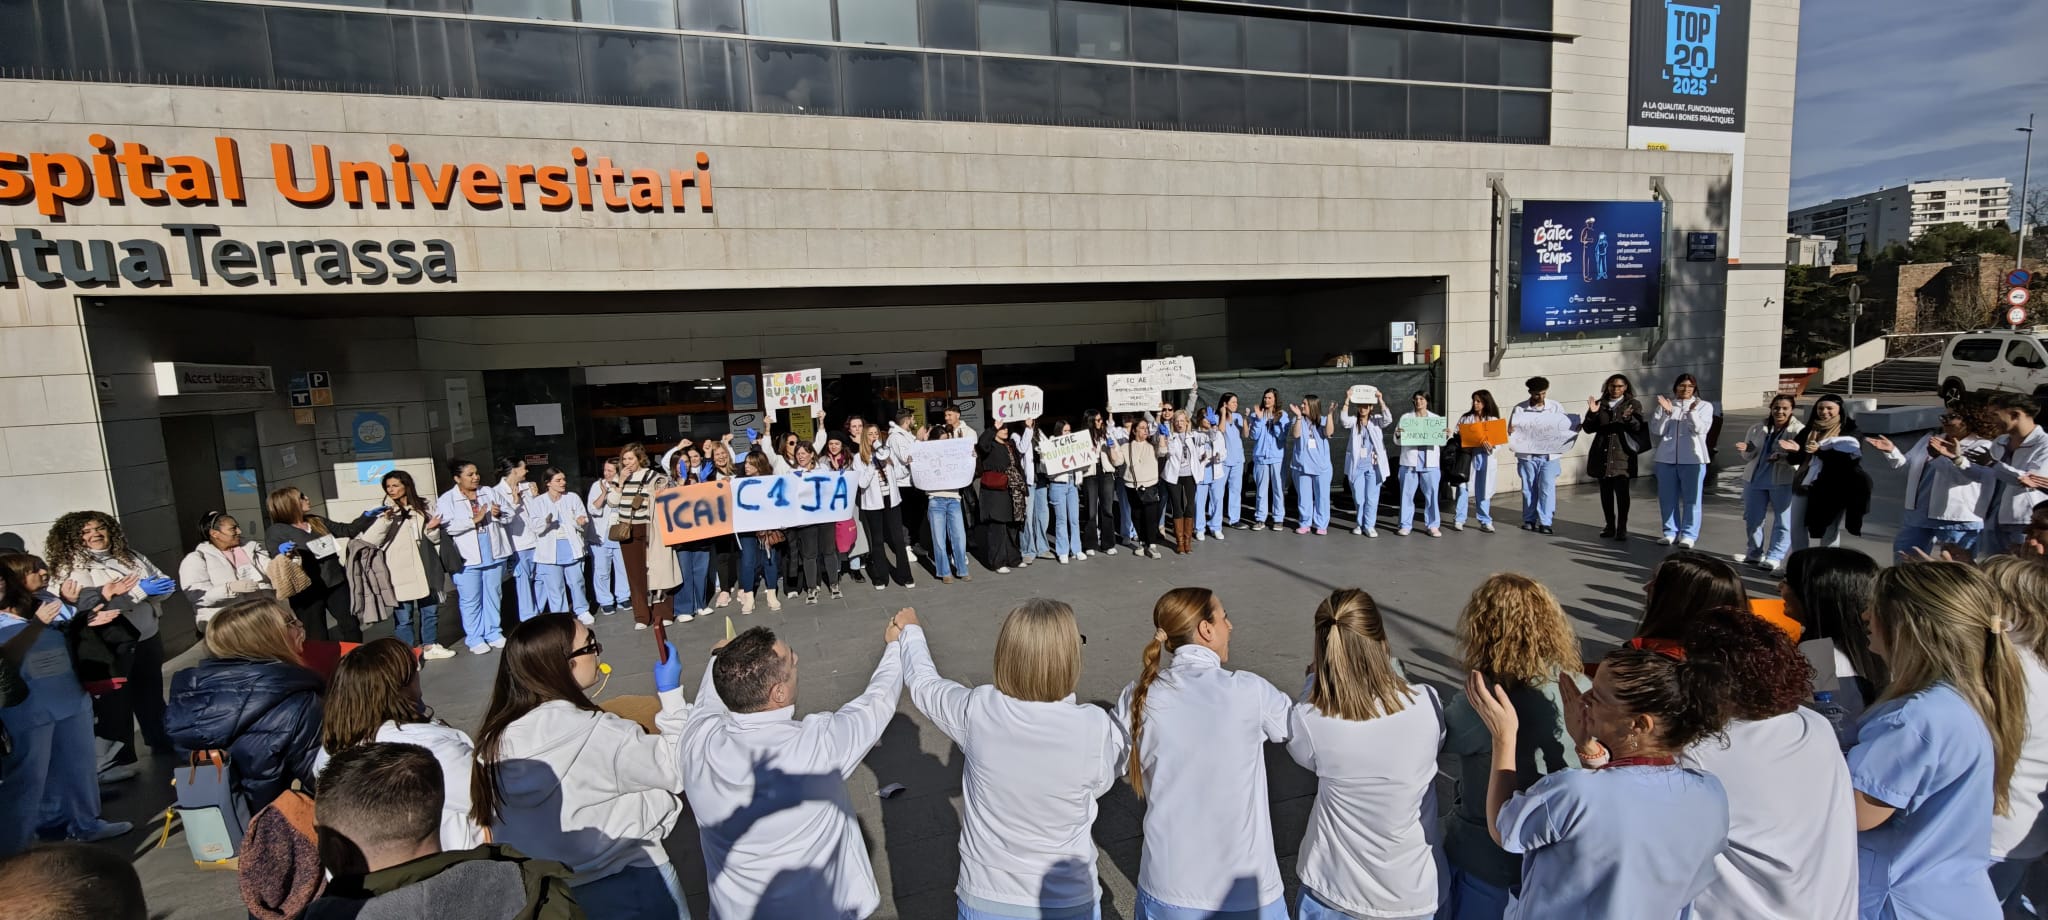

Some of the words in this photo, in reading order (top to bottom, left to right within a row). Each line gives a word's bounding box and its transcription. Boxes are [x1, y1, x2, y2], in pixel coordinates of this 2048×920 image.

[1674, 10, 1711, 43] TOP
[1673, 44, 1709, 78] 20
[1673, 77, 1708, 96] 2025
[1642, 101, 1648, 109] A
[1649, 101, 1657, 109] LA
[1657, 102, 1687, 111] QUALITAT,
[1679, 114, 1699, 122] BONES
[270, 144, 713, 212] Universitari
[998, 389, 1025, 401] TCAE
[998, 404, 1014, 418] C1
[1051, 434, 1077, 448] TCAE
